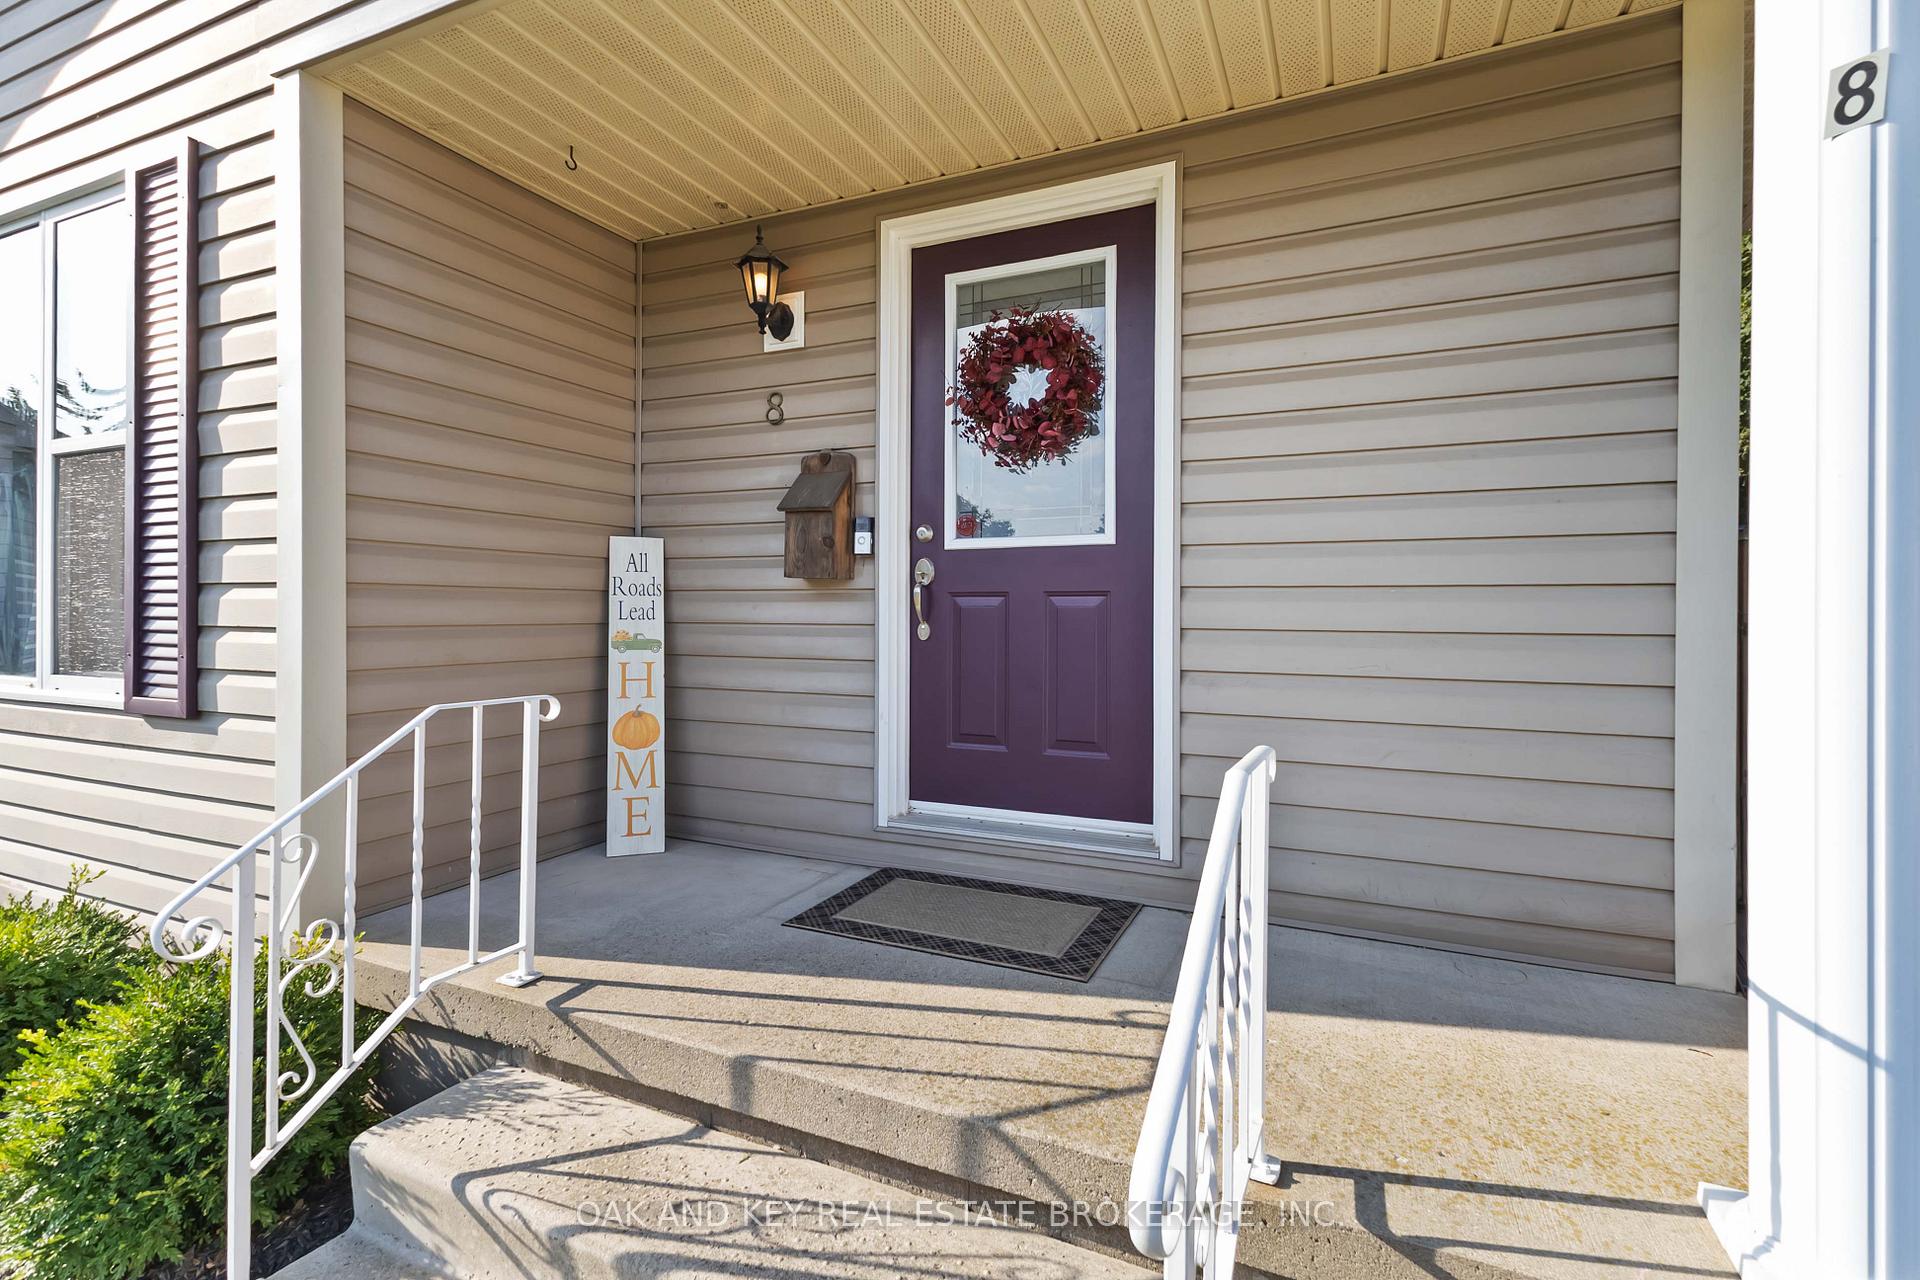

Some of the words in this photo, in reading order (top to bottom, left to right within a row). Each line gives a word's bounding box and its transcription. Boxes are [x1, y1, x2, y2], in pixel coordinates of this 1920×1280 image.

[1834, 61, 1878, 125] 8
[766, 392, 784, 425] 8
[626, 553, 648, 572] All
[611, 576, 662, 597] Roads
[618, 600, 656, 620] Lead
